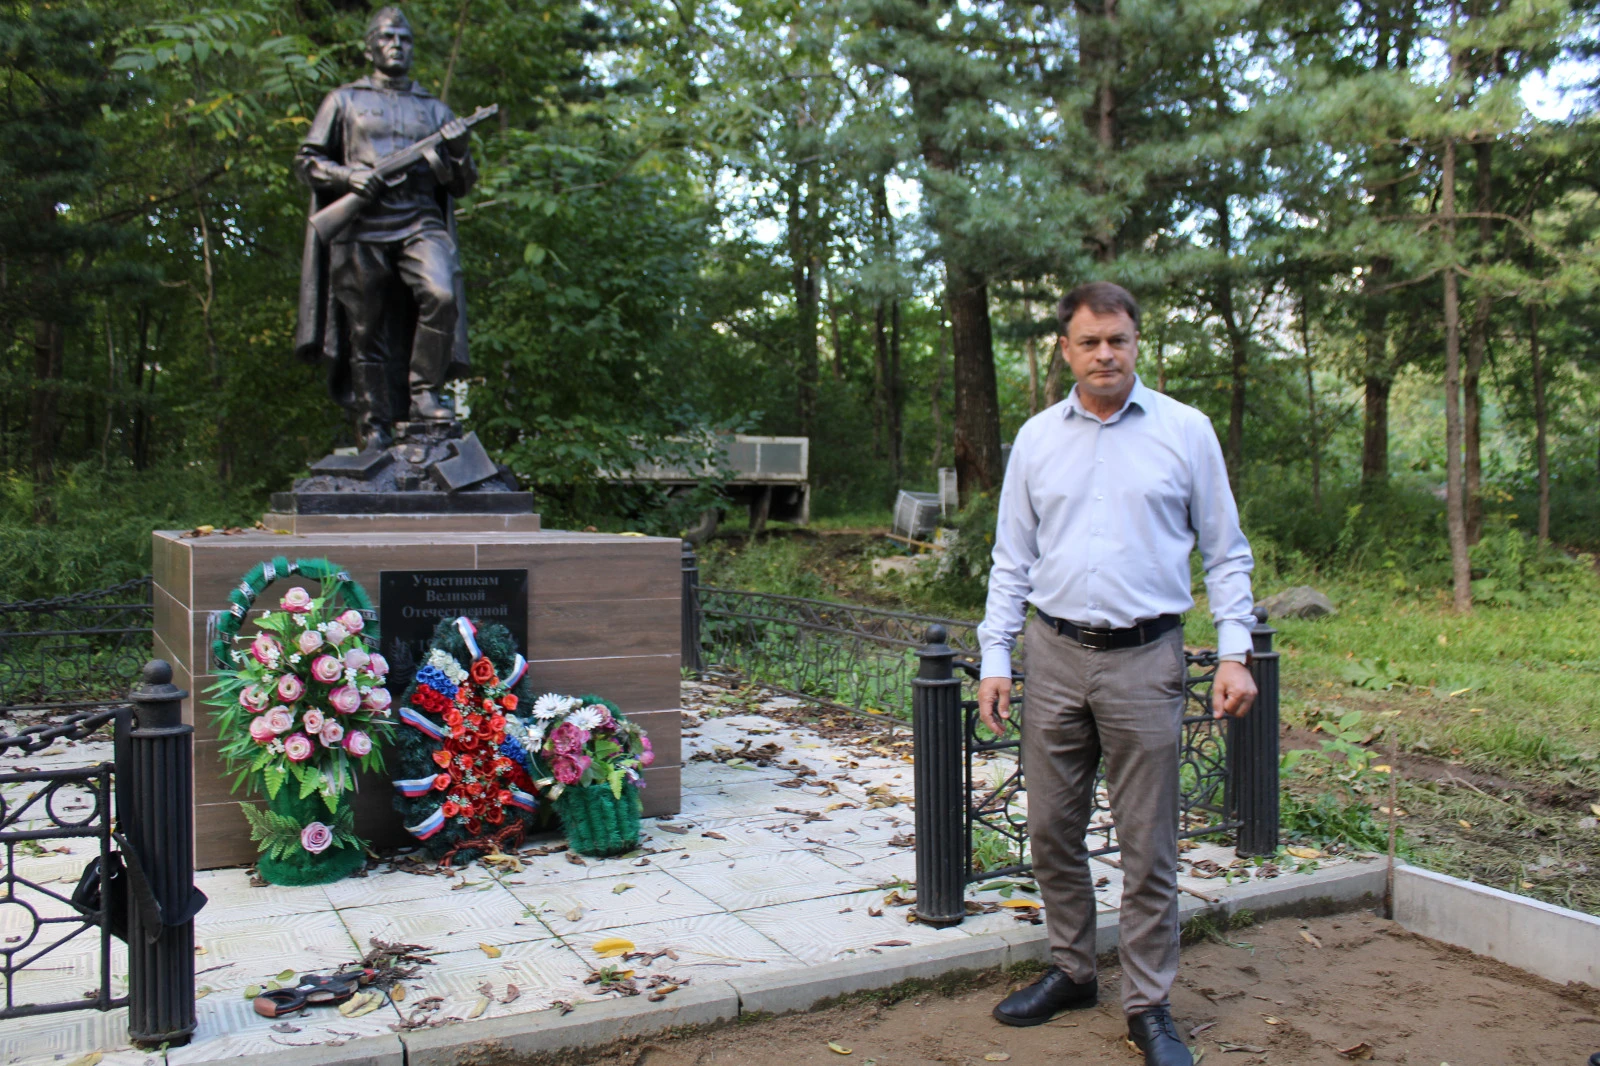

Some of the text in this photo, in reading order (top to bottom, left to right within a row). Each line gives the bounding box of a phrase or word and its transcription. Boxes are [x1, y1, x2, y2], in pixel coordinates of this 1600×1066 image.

[412, 574, 500, 587] Участникам
[425, 589, 486, 602] Великой
[401, 603, 508, 618] Отечественной
